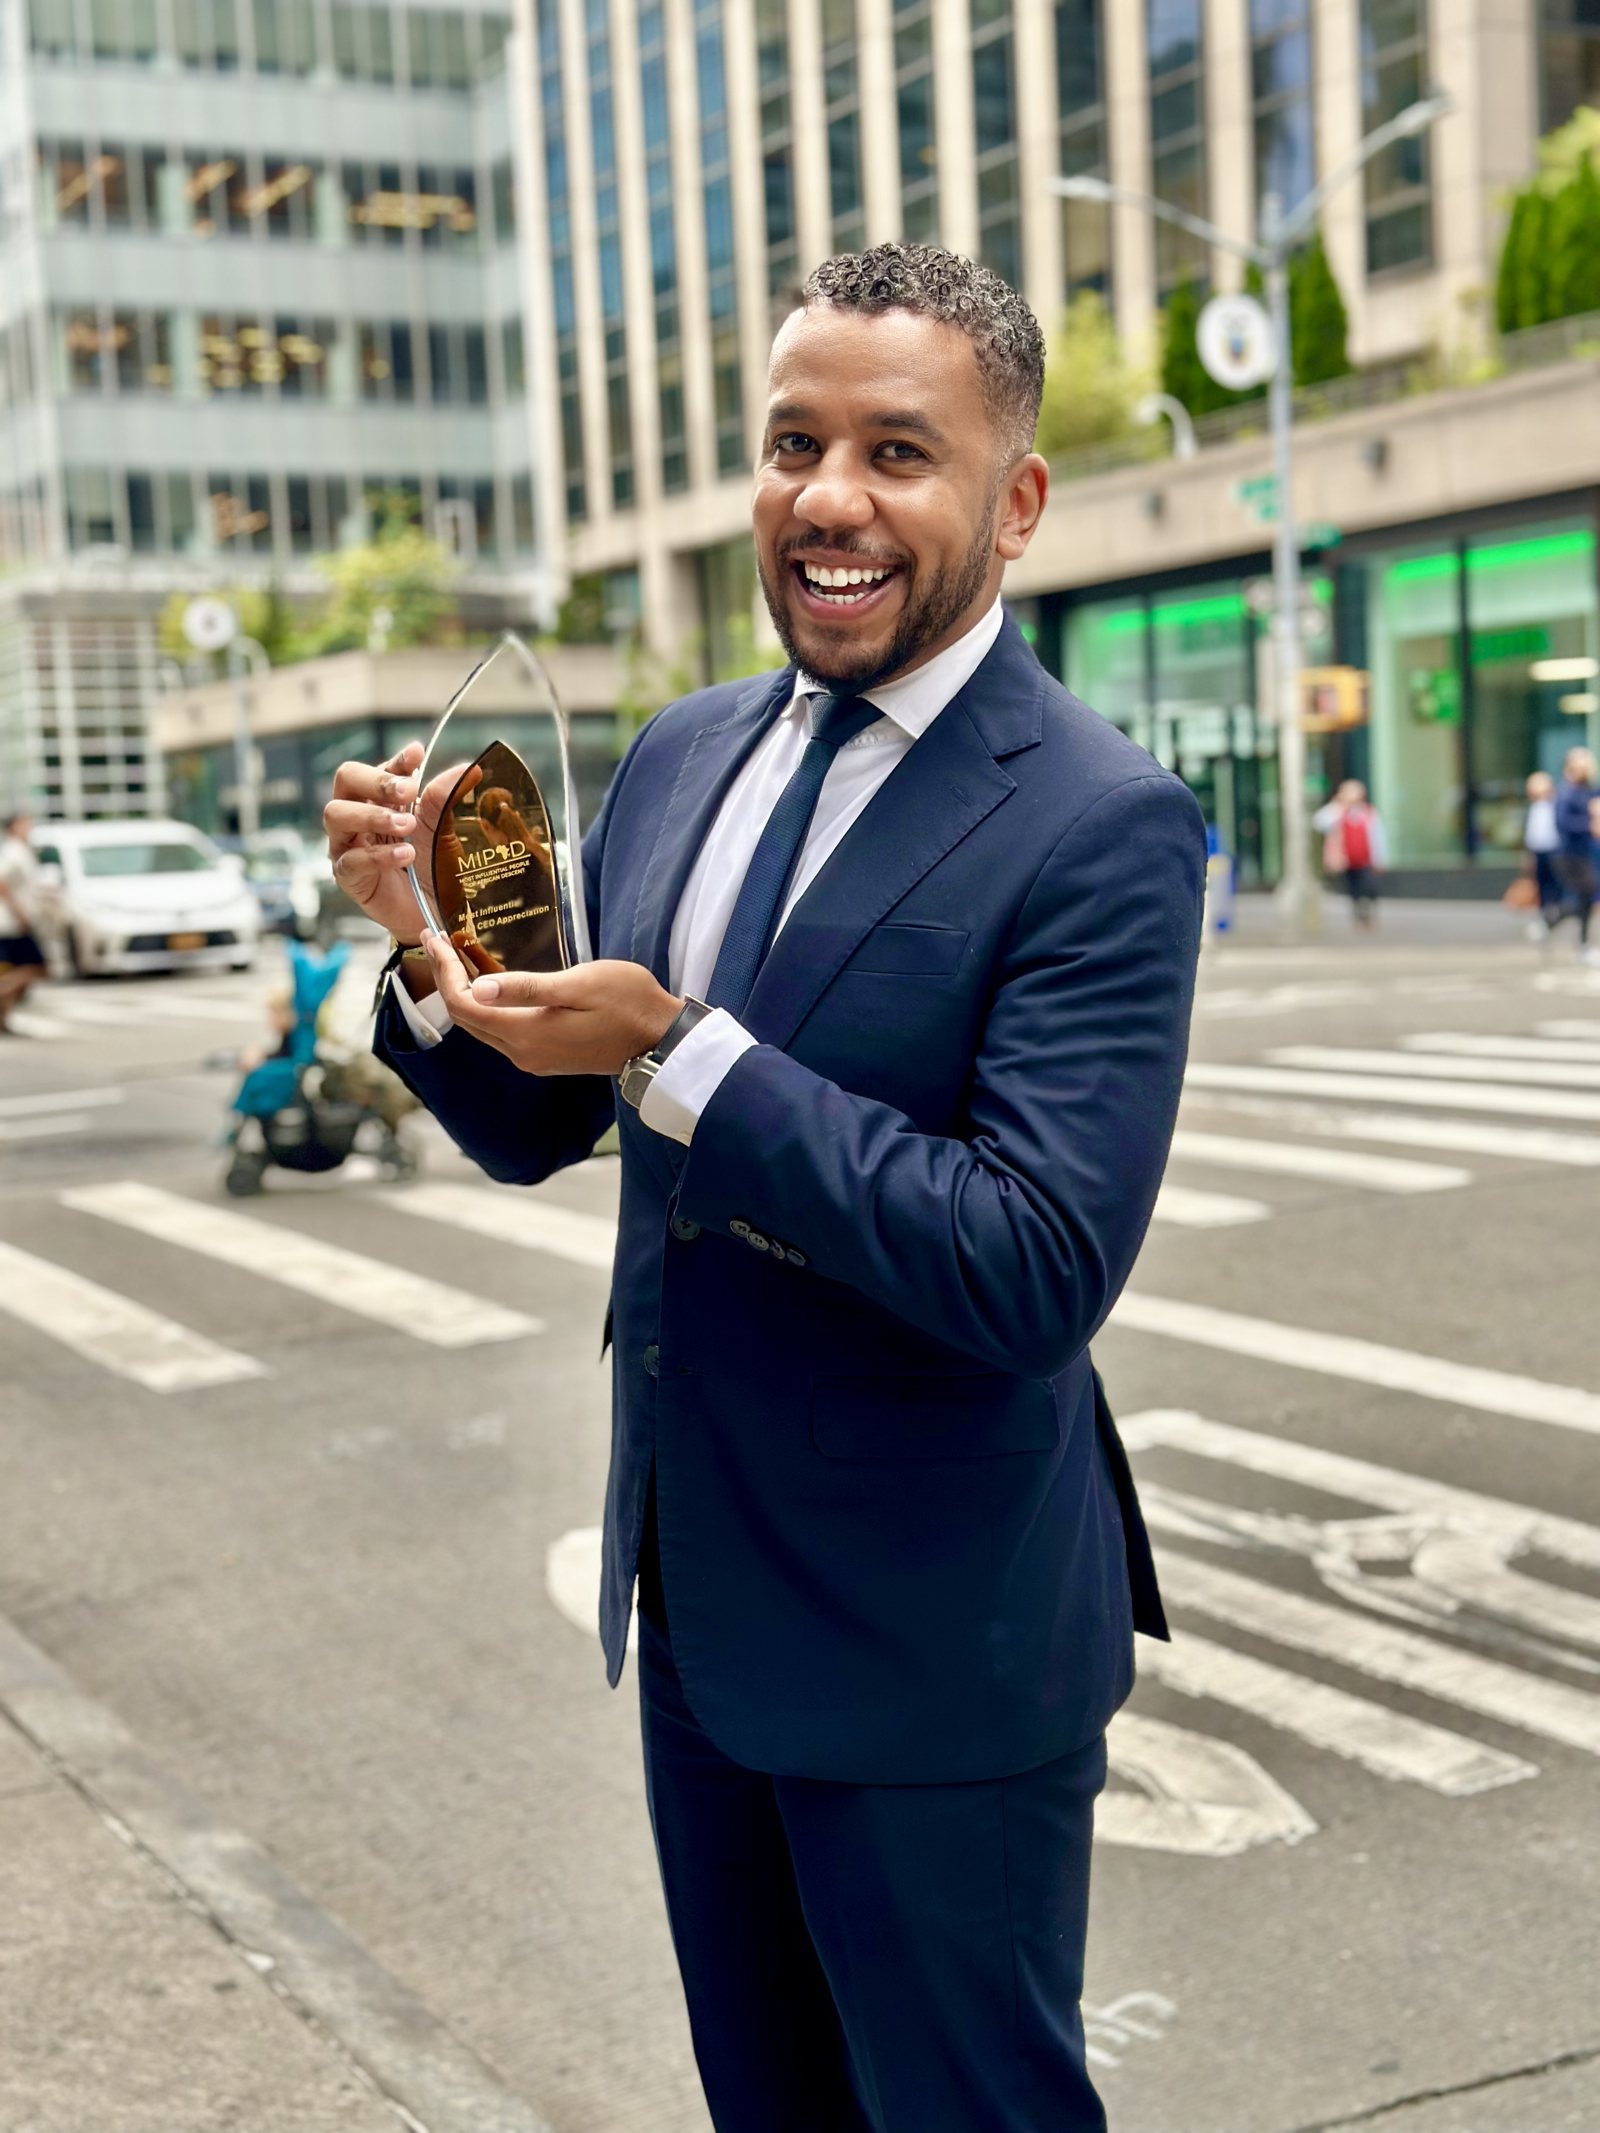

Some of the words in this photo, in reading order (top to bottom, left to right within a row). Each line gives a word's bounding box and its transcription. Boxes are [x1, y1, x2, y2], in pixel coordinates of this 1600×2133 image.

[459, 875, 475, 884] MOST
[475, 866, 509, 880] INFLUENTIAL
[509, 859, 530, 871] PEOPLE
[501, 867, 526, 879] DESCENT
[477, 918, 496, 931] CEO
[496, 905, 549, 925] Appreciation
